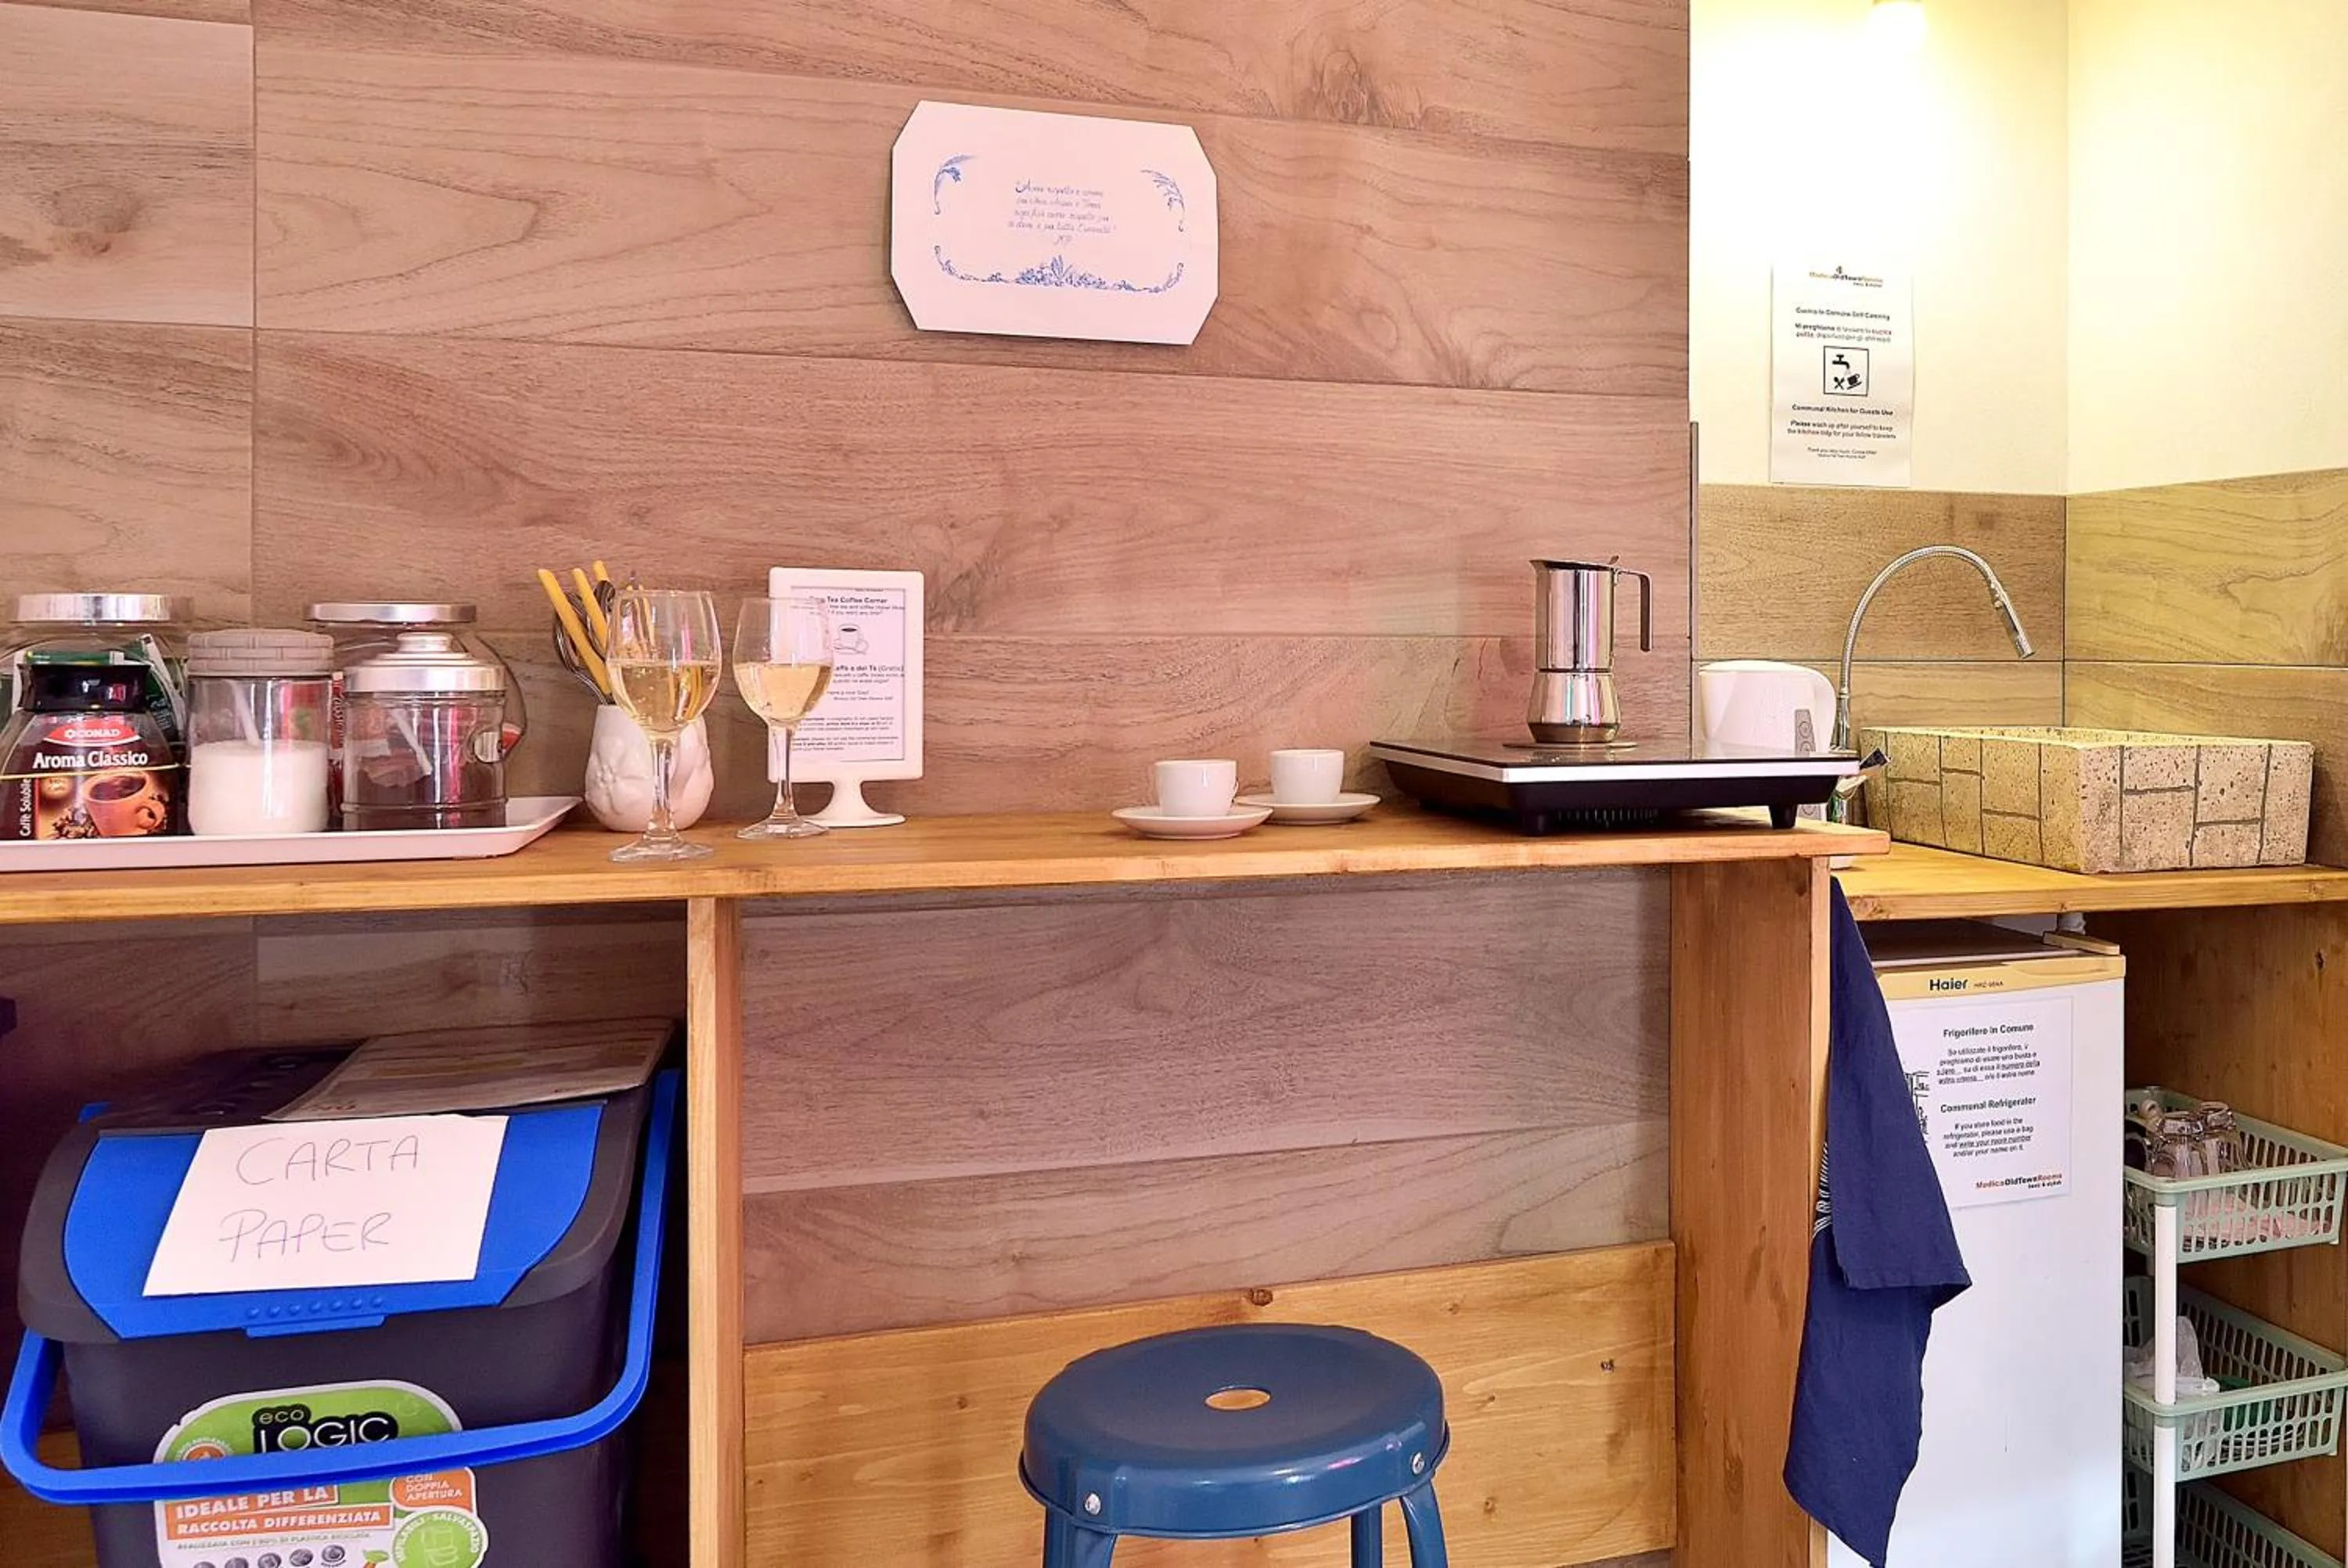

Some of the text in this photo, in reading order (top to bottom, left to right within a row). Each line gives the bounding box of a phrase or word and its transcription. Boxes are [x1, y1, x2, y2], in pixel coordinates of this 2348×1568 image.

[32, 751, 148, 769] Aroma Classico
[1929, 977, 1968, 991] Haier
[1943, 1027, 1988, 1039] Frigorifero
[2000, 1024, 2034, 1034] Comune
[1940, 1096, 2036, 1113] Communal Refrigerator
[236, 1135, 419, 1185] CARTA
[219, 1209, 392, 1264] PAPER
[259, 1410, 304, 1425] eco
[406, 1473, 433, 1483] CON
[407, 1480, 450, 1492] DOPPIA
[175, 1486, 329, 1519] IDEALE PER LA
[406, 1489, 463, 1501] APERTURA
[176, 1510, 382, 1535] RACCOLTA DIFFERENZIATA
